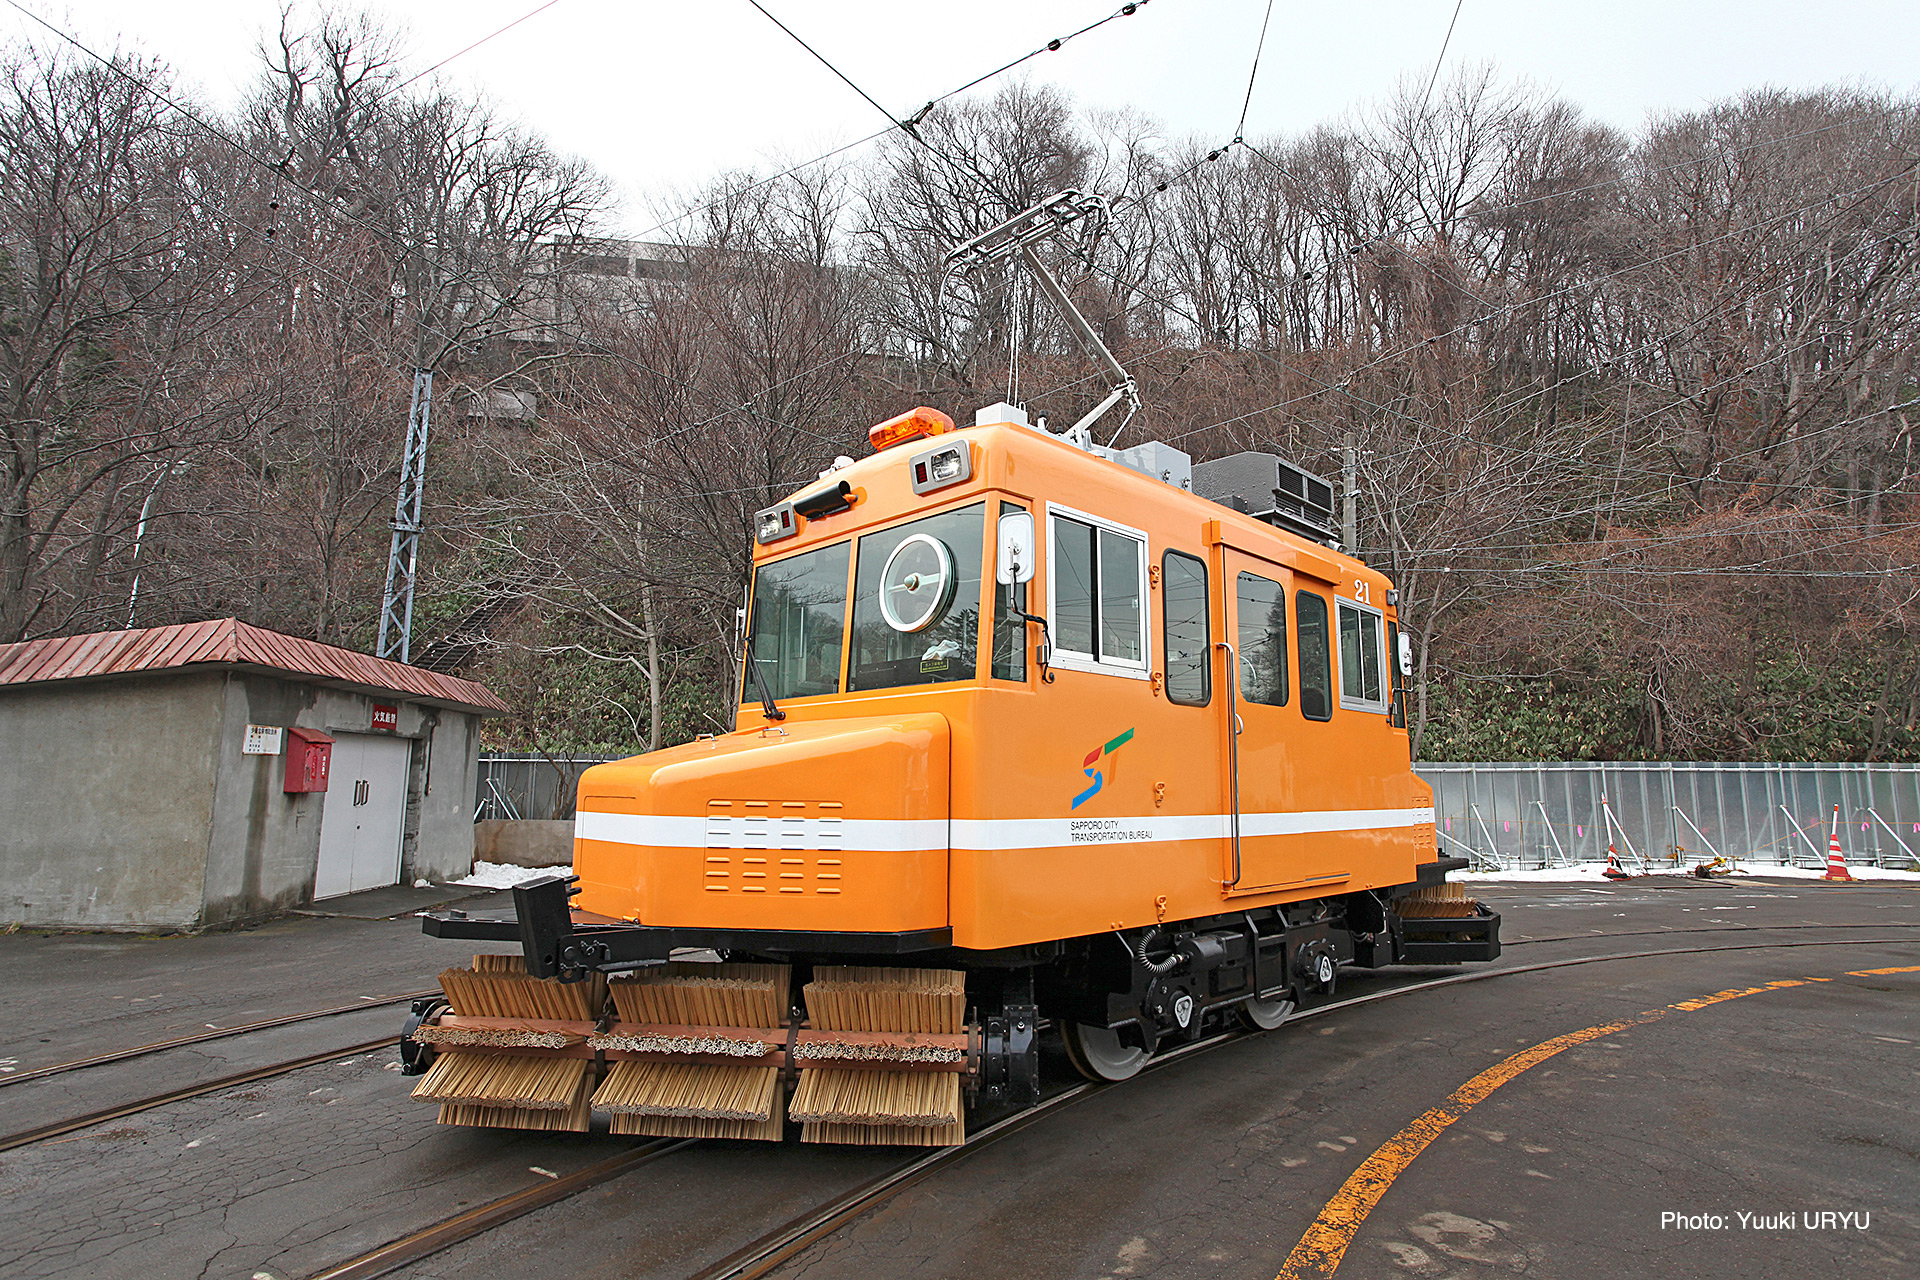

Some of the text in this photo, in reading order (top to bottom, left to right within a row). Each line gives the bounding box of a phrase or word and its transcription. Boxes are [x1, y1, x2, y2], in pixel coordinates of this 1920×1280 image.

[1354, 579, 1371, 604] 21
[1071, 821, 1119, 830] SAPPORO CITY
[1071, 831, 1152, 842] TRANSPORTATION BUREAU
